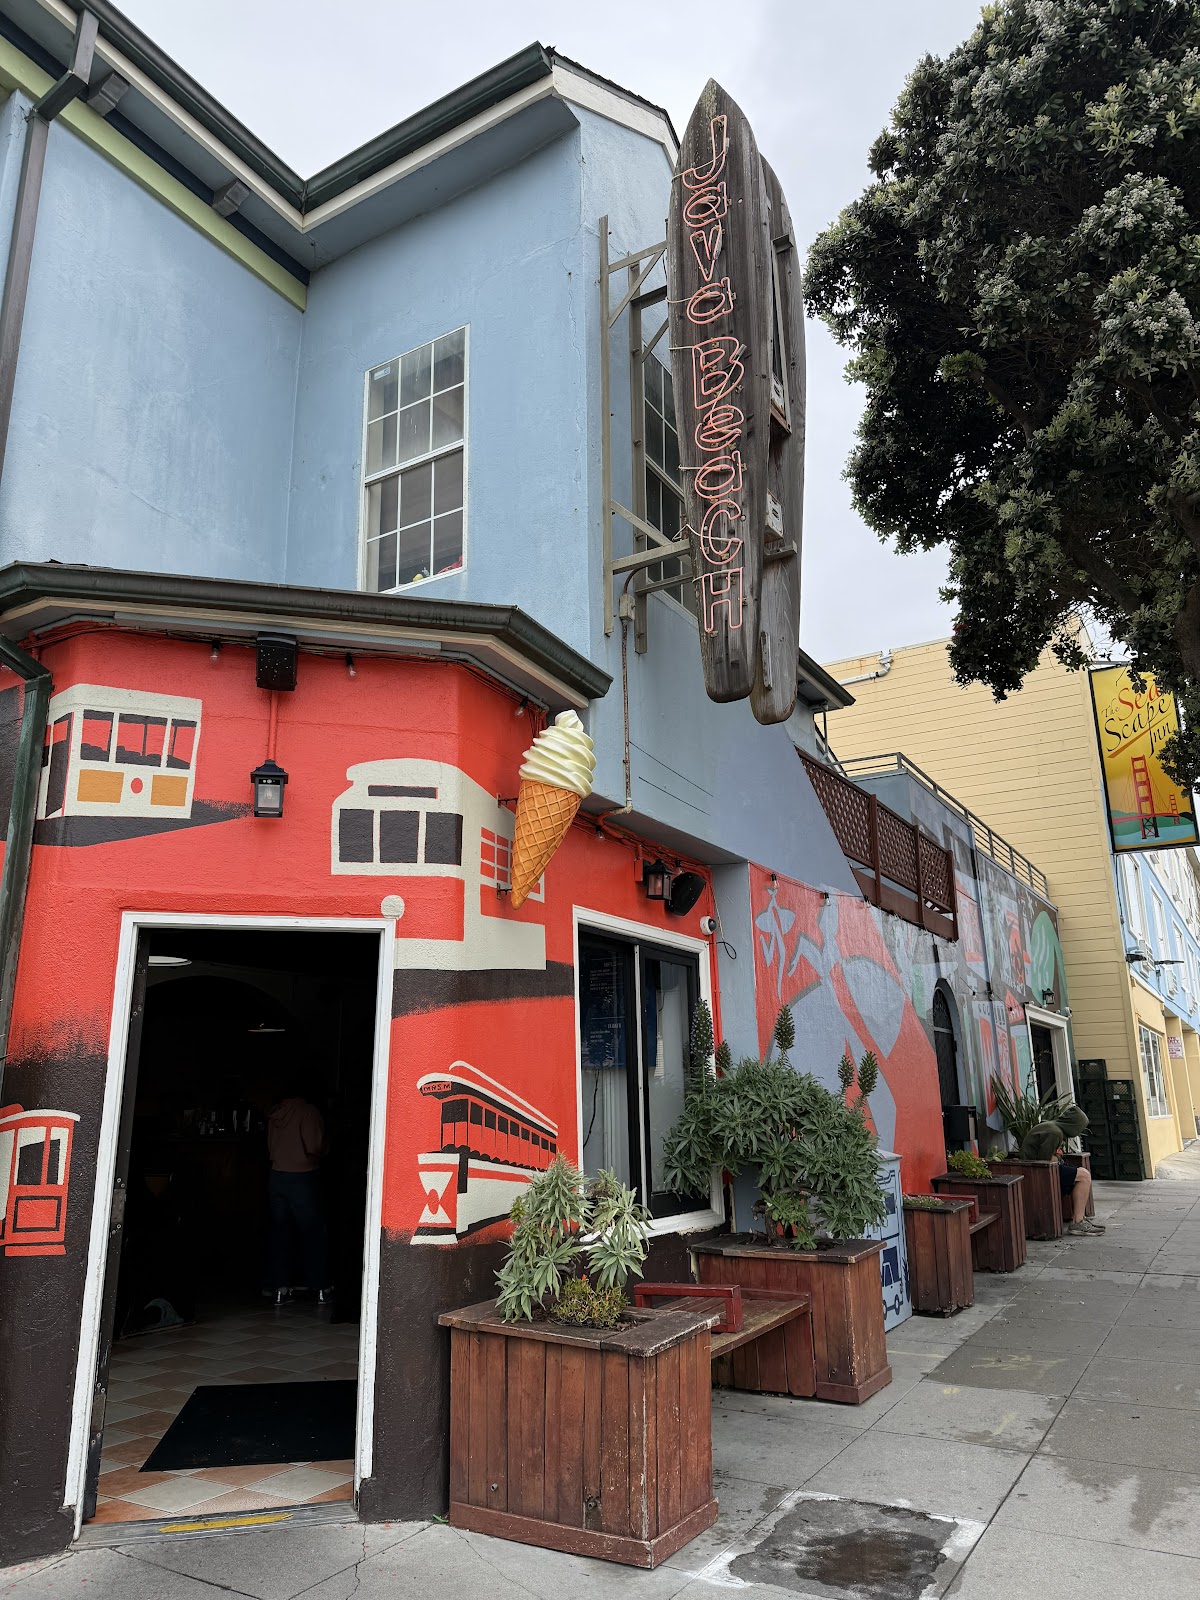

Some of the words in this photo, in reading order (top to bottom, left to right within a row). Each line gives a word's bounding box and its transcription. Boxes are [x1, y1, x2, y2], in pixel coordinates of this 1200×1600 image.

[1101, 698, 1120, 718] The
[1118, 684, 1161, 721] Sea
[1105, 698, 1172, 752] Scape
[1149, 722, 1175, 758] Inn
